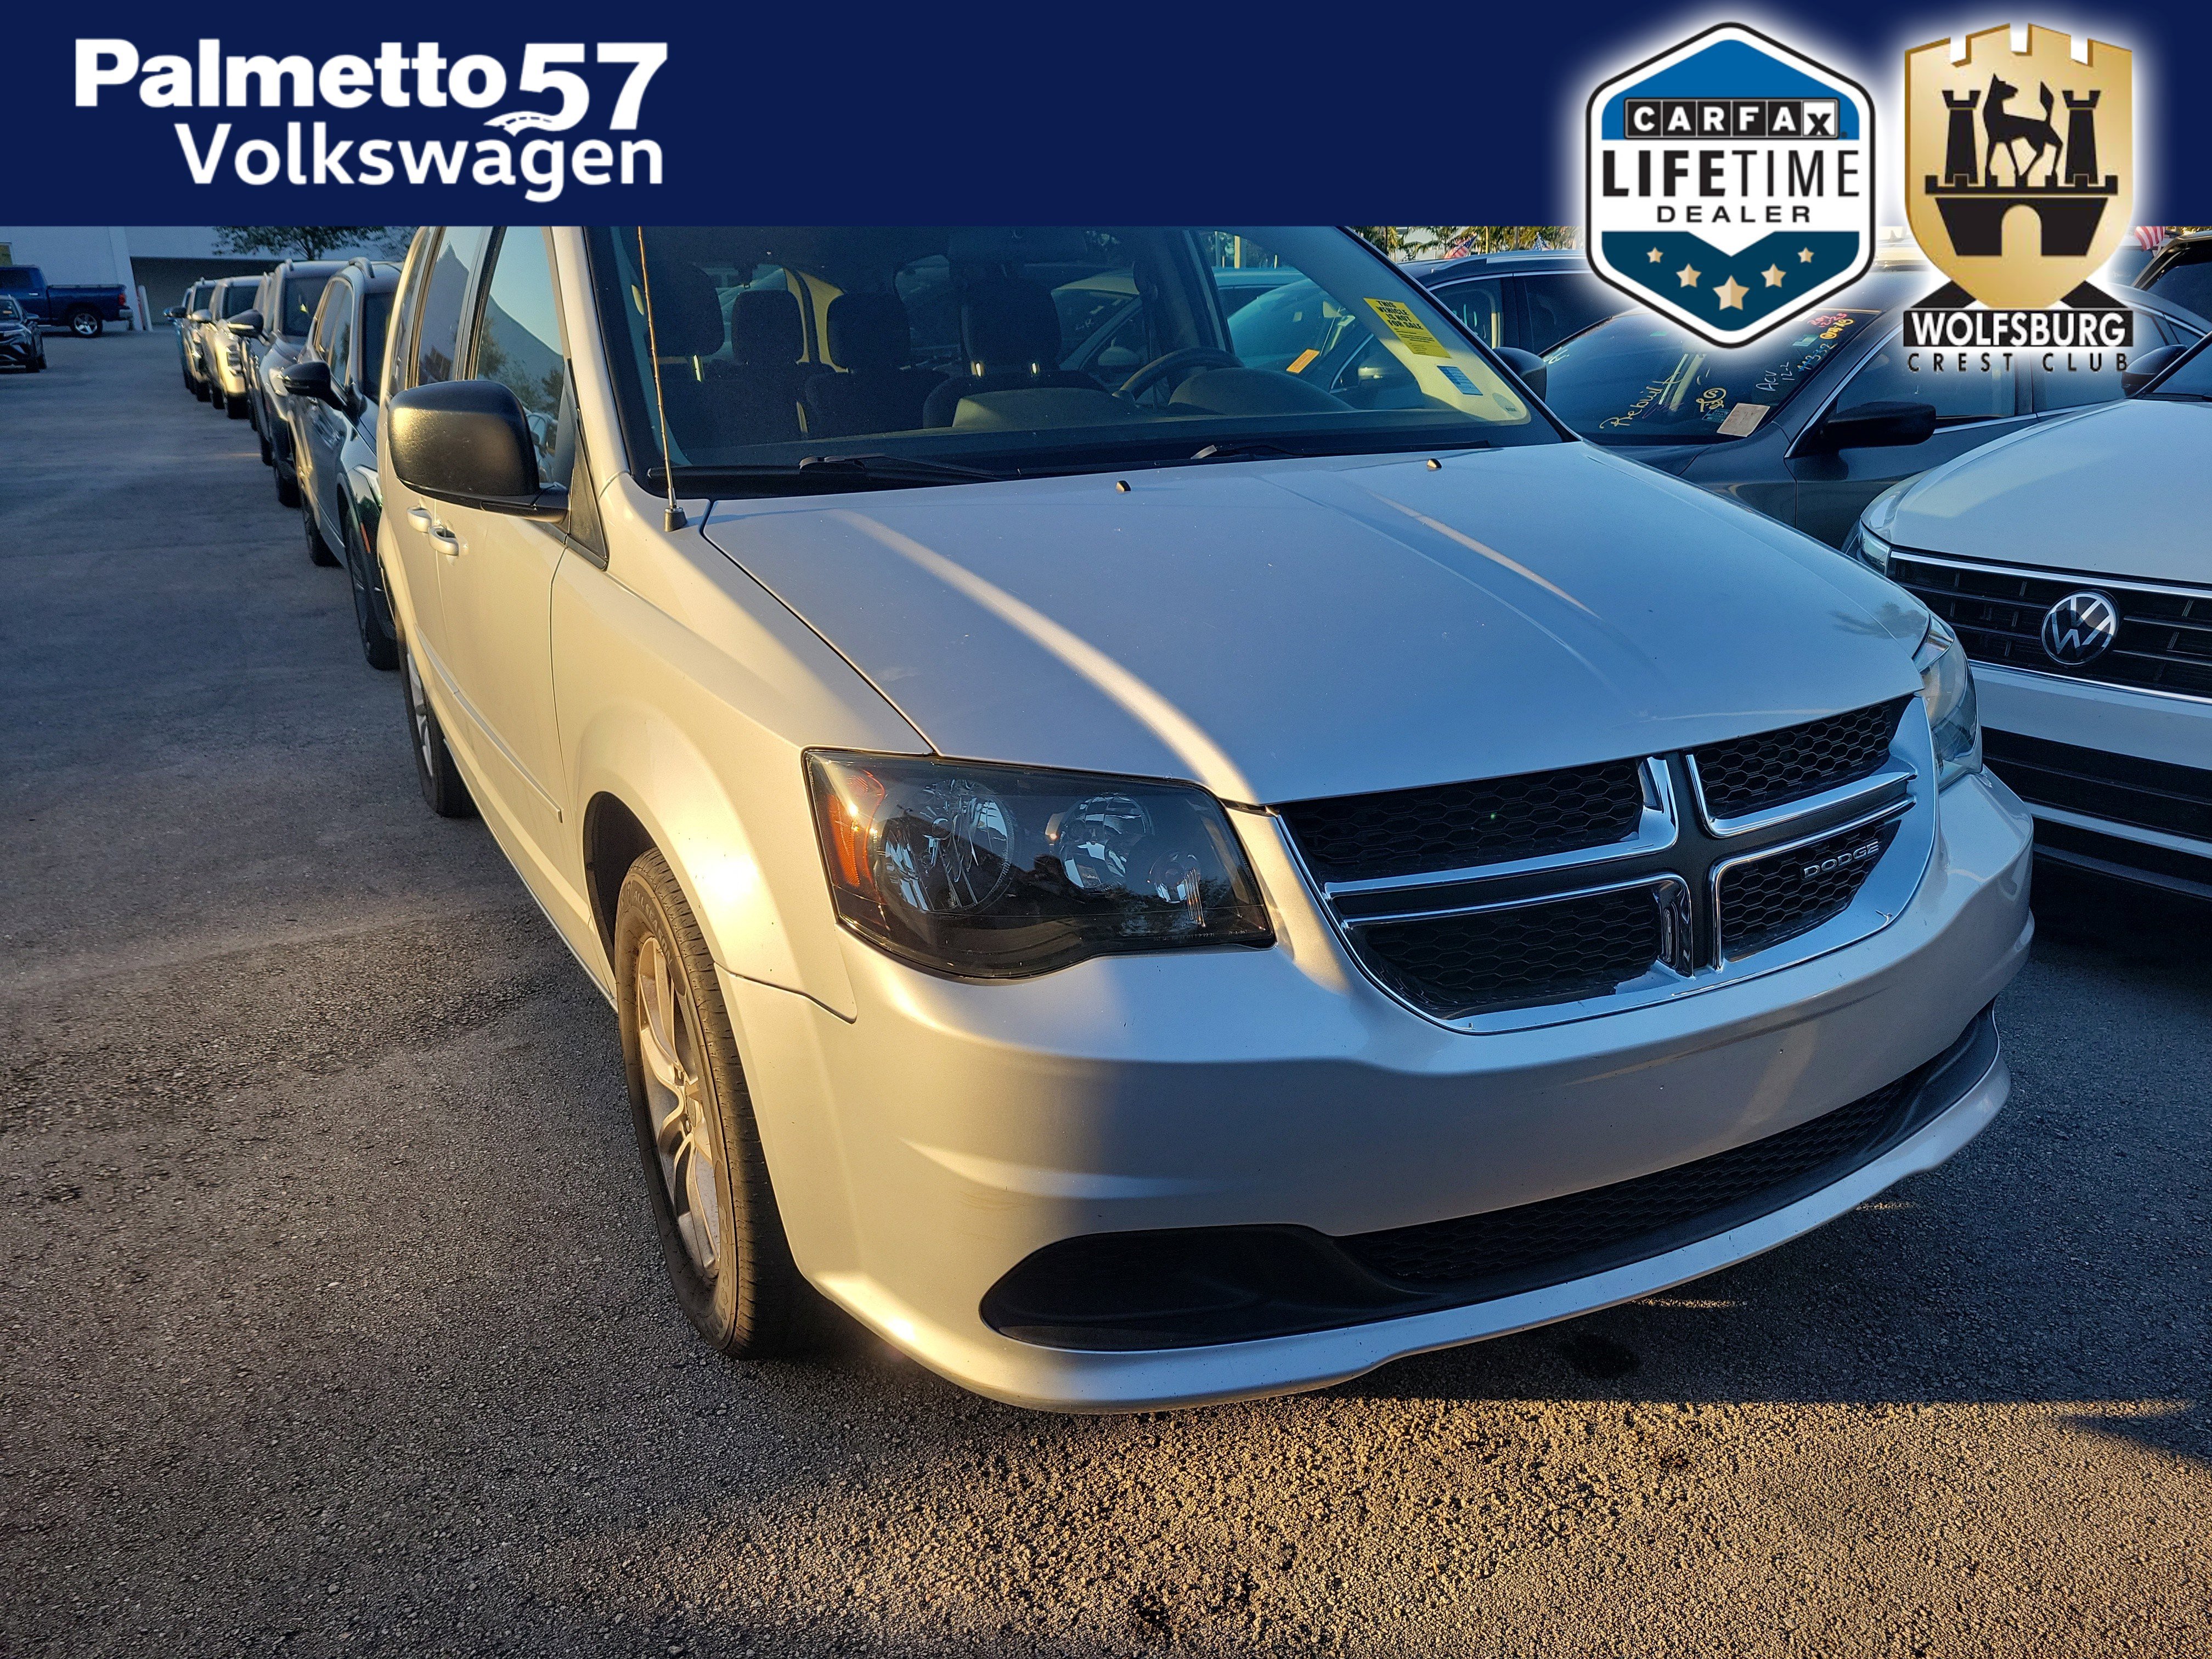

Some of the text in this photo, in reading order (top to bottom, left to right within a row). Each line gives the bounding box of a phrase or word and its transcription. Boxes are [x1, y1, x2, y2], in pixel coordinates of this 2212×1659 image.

[1376, 306, 1409, 316] VEHICLE
[1395, 314, 1413, 323] NOT
[1404, 321, 1424, 330] SALE
[1803, 840, 1880, 878] DODGE
